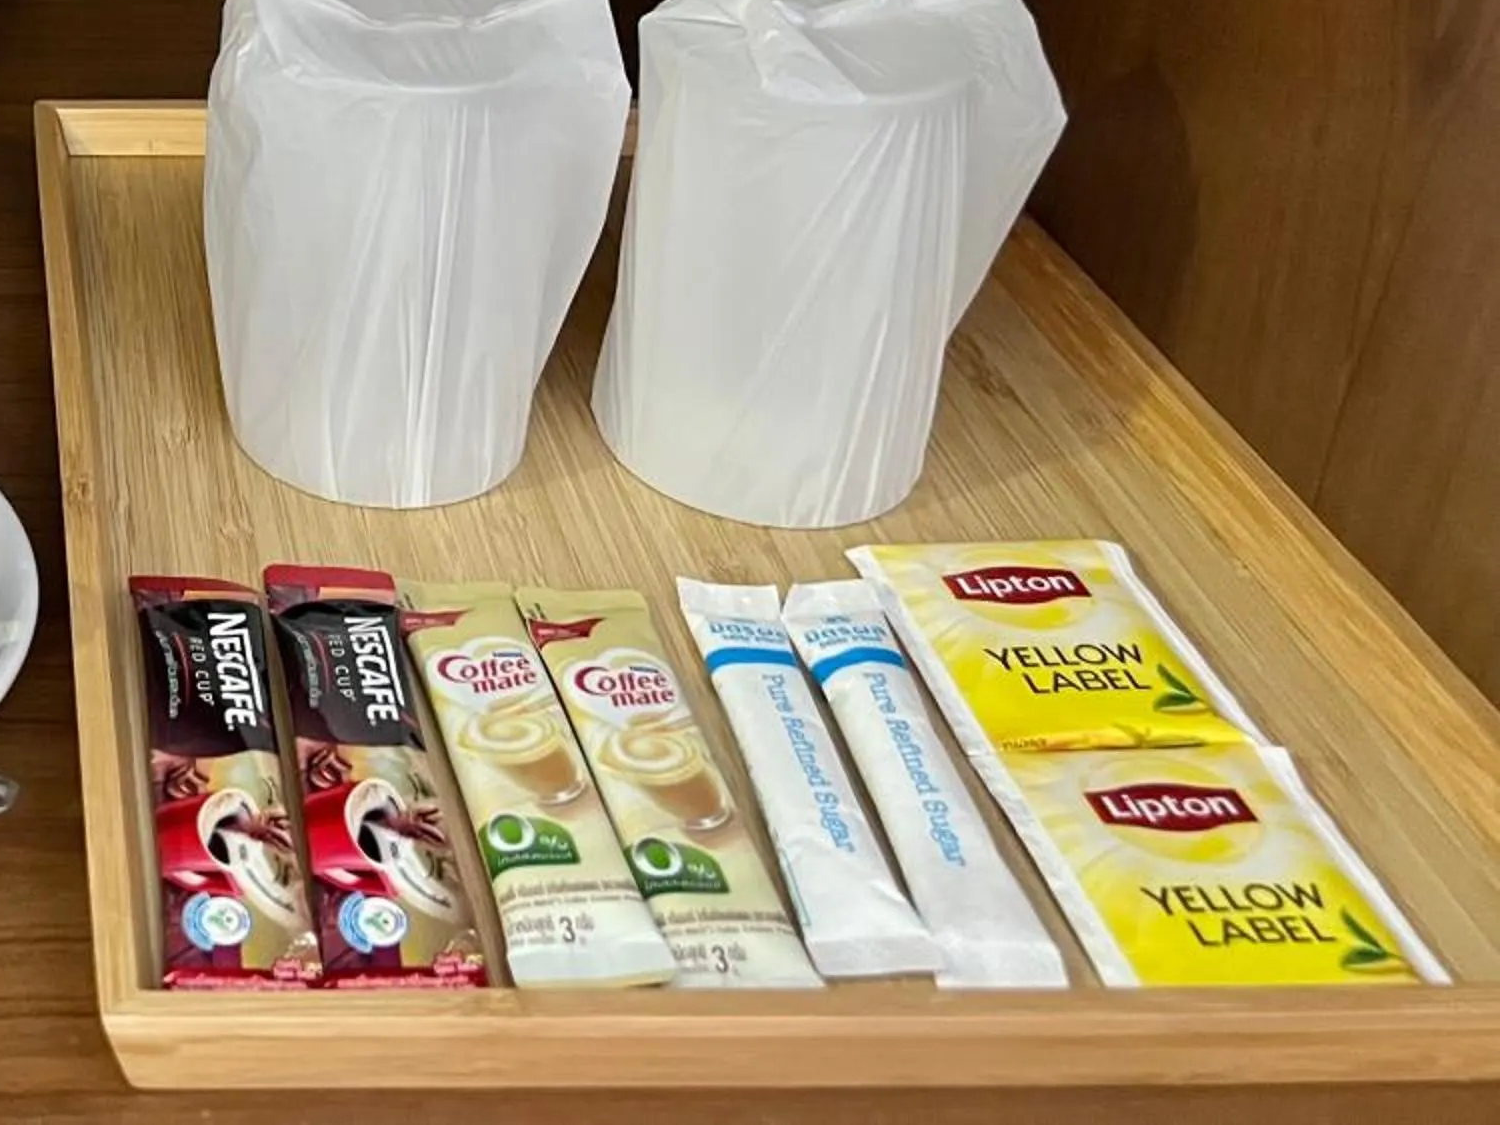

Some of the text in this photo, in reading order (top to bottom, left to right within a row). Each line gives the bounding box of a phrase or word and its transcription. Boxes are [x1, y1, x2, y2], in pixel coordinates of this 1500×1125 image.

[956, 574, 1075, 598] Lipton
[437, 654, 531, 684] Coffee
[983, 643, 1144, 672] YELLOW
[195, 670, 213, 704] CUP
[335, 665, 354, 699] CUP
[472, 672, 538, 694] mate
[574, 666, 667, 696] Coffee
[1023, 668, 1152, 695] LABEL
[610, 690, 675, 708] mate
[762, 673, 856, 853] Pure Refined Sugar
[864, 672, 965, 867] Pure Refined Sugar
[1101, 793, 1240, 823] Lipton
[1140, 882, 1324, 916] YELLOW
[559, 916, 576, 943] 3
[1186, 915, 1337, 947] LABEL
[711, 944, 729, 973] 3
